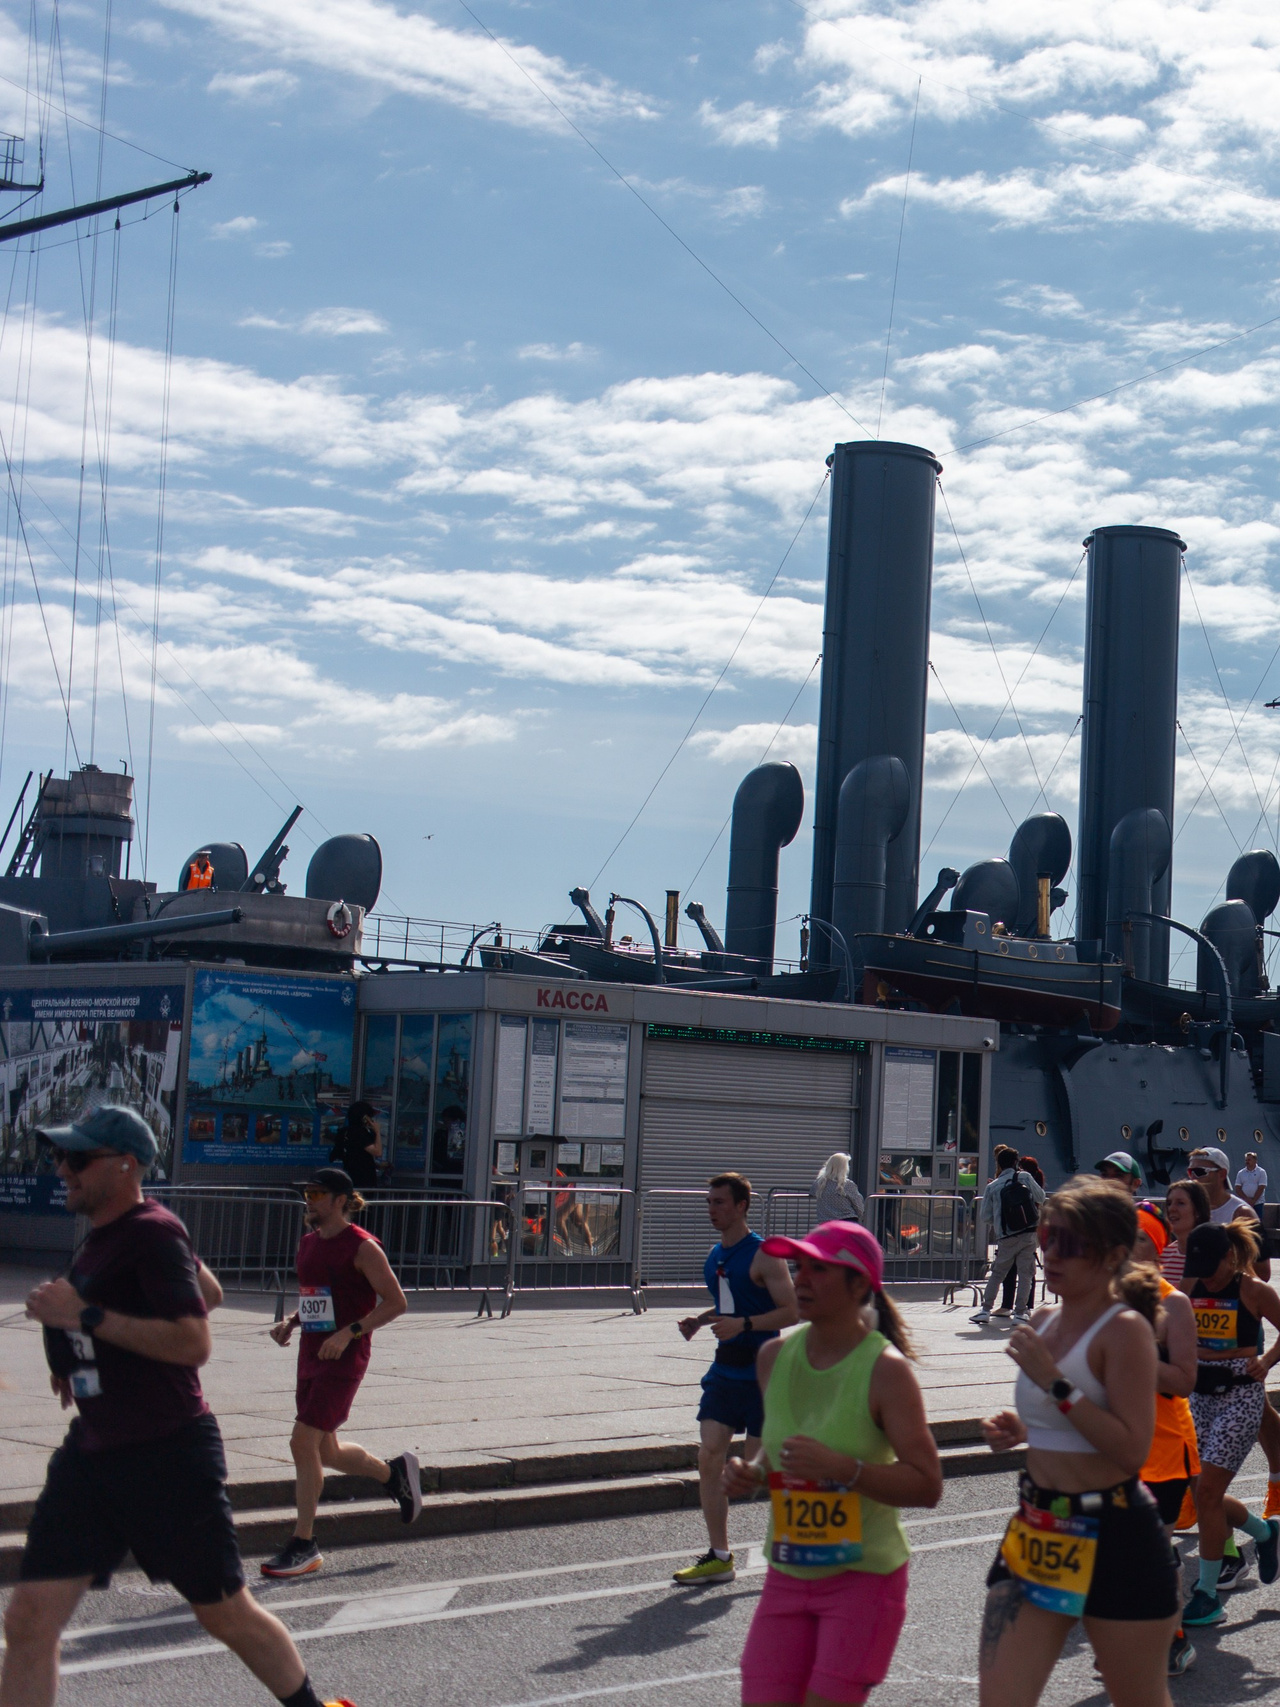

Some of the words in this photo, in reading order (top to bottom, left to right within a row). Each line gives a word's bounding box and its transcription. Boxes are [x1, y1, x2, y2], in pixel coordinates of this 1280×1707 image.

[31, 997, 70, 1008] ЦЕНТРАЛЬНЫЙ
[71, 996, 121, 1008] ВОЕННО-МОРСКОЙ
[122, 995, 141, 1006] МУЗЕЙ
[537, 988, 609, 1012] КАССА
[34, 1010, 54, 1019] ИМЕНИ
[54, 1009, 88, 1018] ИМПЕРАТОРА
[89, 1009, 106, 1018] ПЕТРА
[107, 1008, 135, 1018] ВЕЛИКОГО
[302, 1300, 327, 1314] 6307
[785, 1499, 847, 1528] 1206
[779, 1545, 789, 1562] E
[1019, 1532, 1081, 1574] 1054
